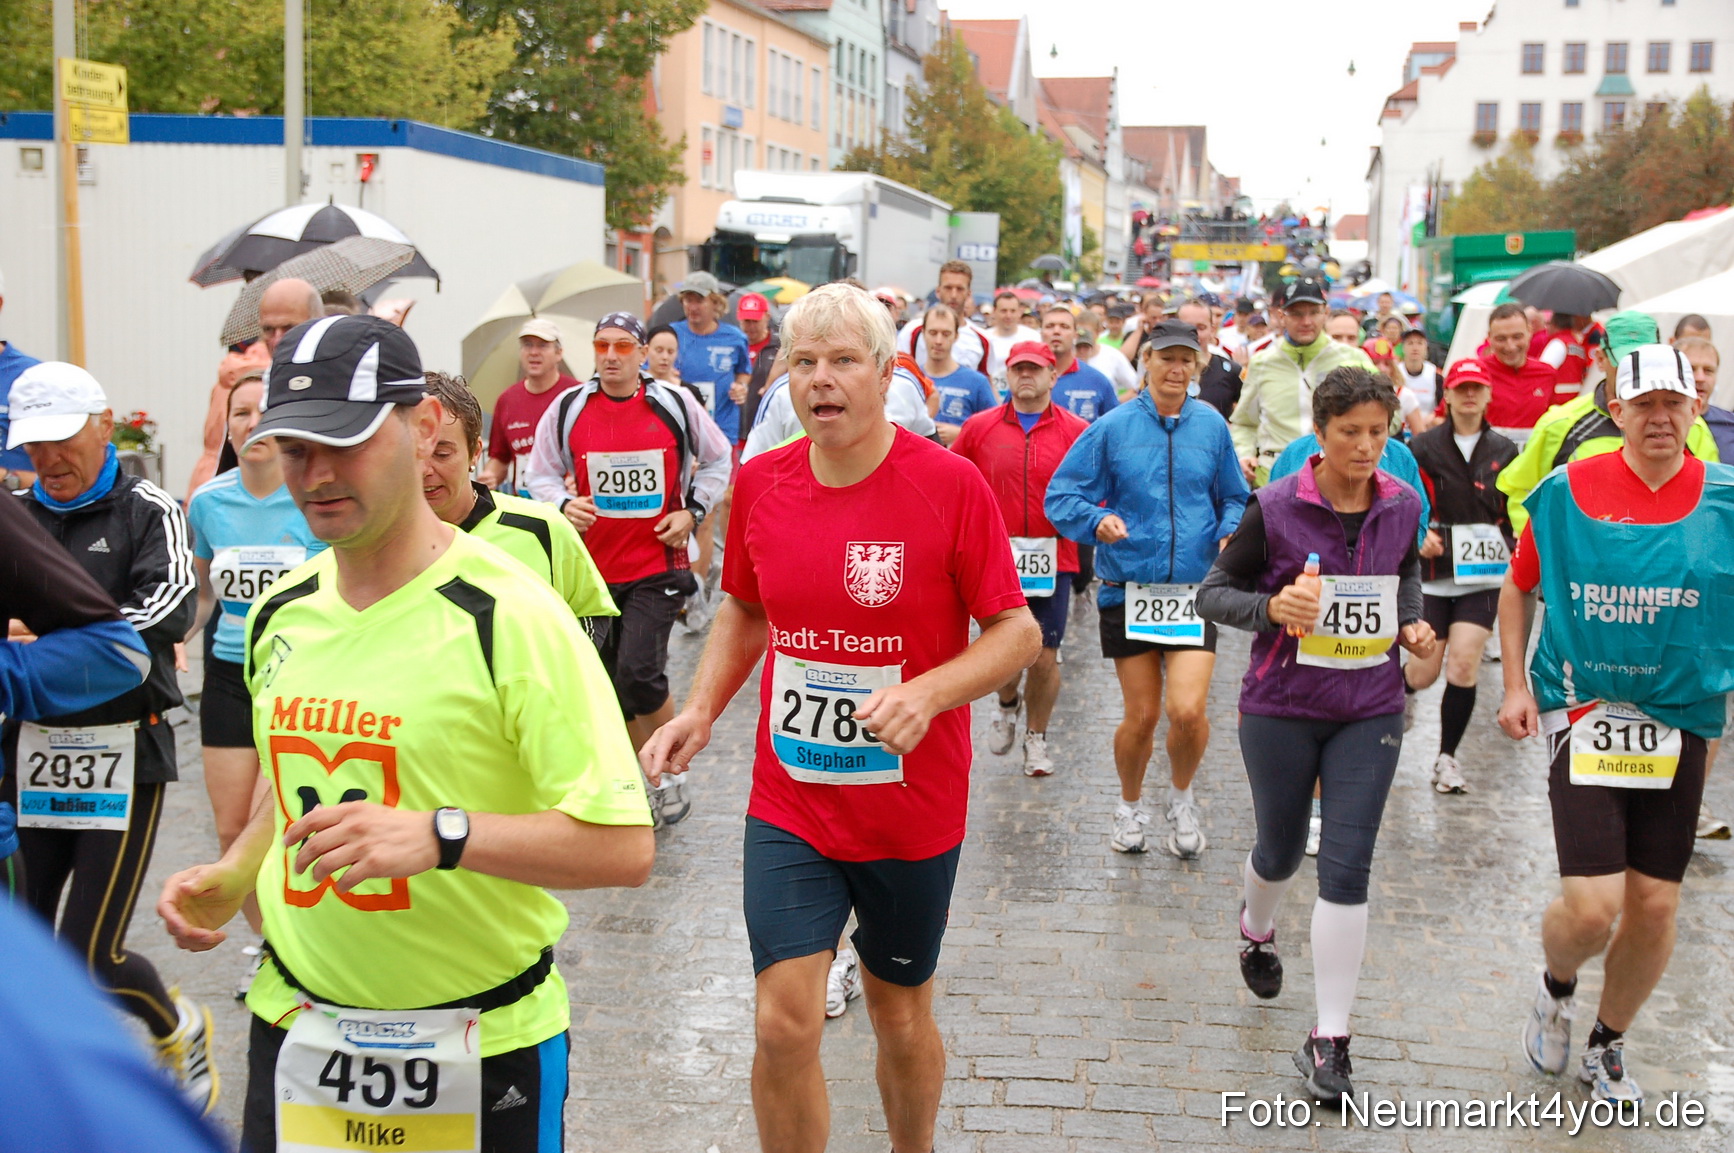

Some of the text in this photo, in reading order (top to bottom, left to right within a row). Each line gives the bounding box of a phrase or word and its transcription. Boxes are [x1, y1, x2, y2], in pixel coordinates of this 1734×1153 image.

[597, 468, 657, 494] 2983
[606, 499, 649, 510] Siegfried
[1461, 541, 1505, 561] 2452
[1135, 599, 1196, 622] 2824
[1322, 601, 1382, 634] 455
[1584, 602, 1661, 625] POINT
[1334, 642, 1366, 656] Anna
[805, 668, 857, 685] BOCK
[269, 696, 402, 741] Müller
[1593, 720, 1658, 752] 310
[28, 751, 122, 789] 2937
[796, 746, 866, 771] Stephan
[1597, 759, 1654, 774] Andreas
[337, 1019, 417, 1037] BOCK
[317, 1049, 440, 1109] 459
[345, 1119, 406, 1146] Mike
